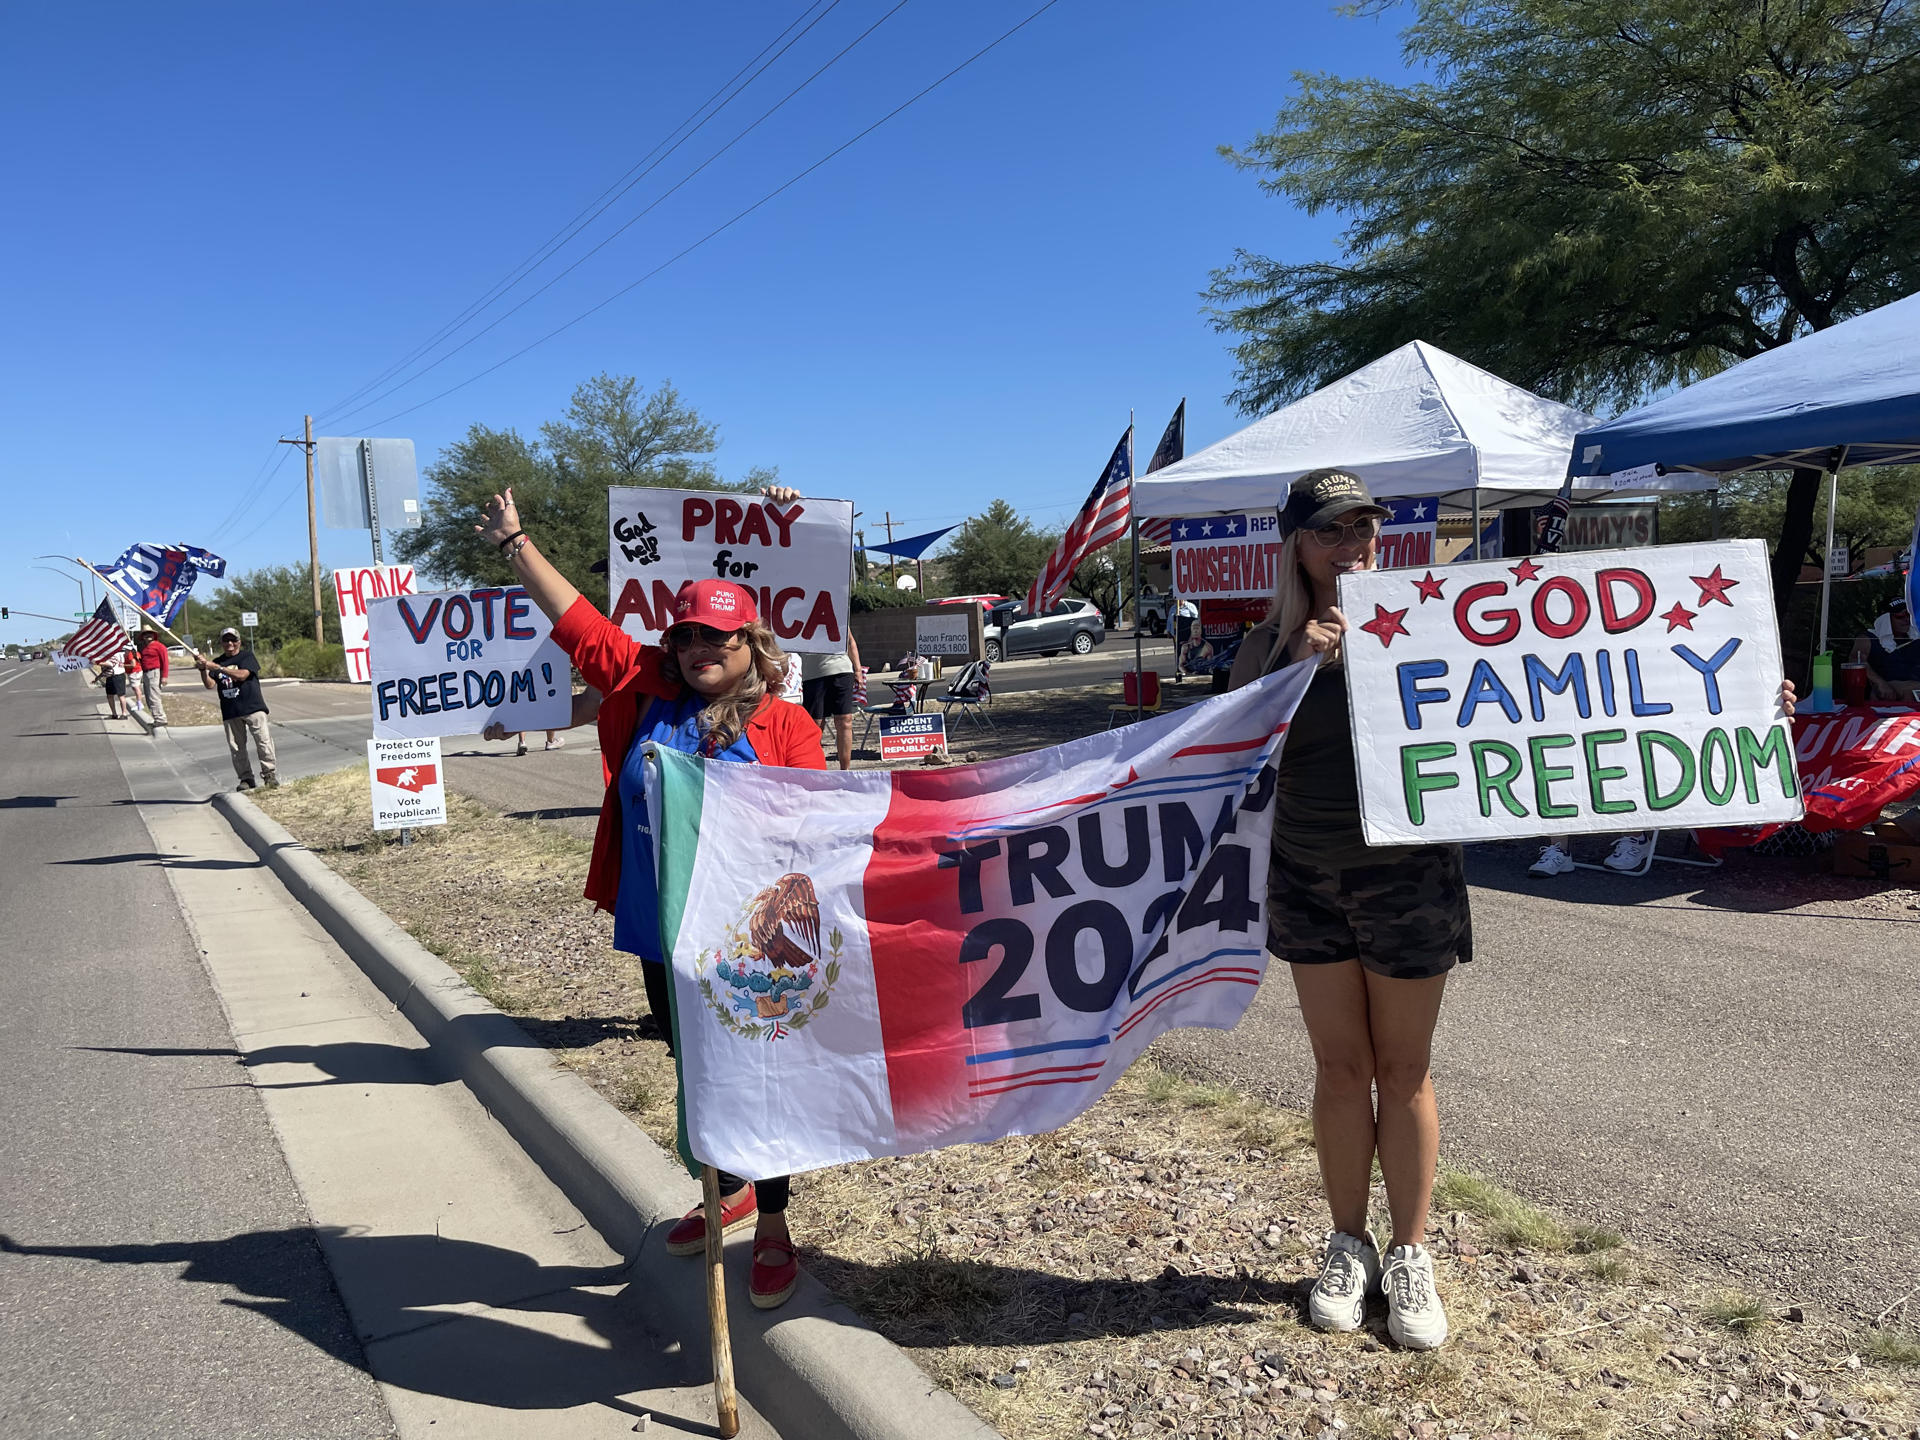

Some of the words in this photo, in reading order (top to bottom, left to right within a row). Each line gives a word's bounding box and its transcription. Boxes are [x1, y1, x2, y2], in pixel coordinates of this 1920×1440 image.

[1315, 474, 1357, 490] TRUMP
[1327, 484, 1350, 493] 2020
[613, 511, 657, 542] God
[682, 497, 805, 548] PRAY
[1561, 515, 1649, 546] MMY'S
[620, 536, 658, 563] help
[713, 550, 759, 579] for
[334, 568, 414, 617] HONK
[716, 590, 735, 599] PURO
[709, 602, 735, 612] TRUMP
[710, 596, 736, 606] PAPI
[1453, 567, 1656, 647] GOD
[397, 587, 537, 644] VOTE
[611, 578, 841, 642] AMICA
[918, 633, 939, 642] Aaron
[940, 632, 967, 642] Franco
[446, 639, 483, 662] FOR
[918, 643, 967, 653] 520.825.1800
[377, 662, 556, 721] FREEDOM!
[1397, 637, 1742, 730] FAMILY
[889, 717, 933, 726] STUDENT
[890, 724, 933, 734] SUCCESS
[375, 741, 413, 751] Protect
[416, 739, 434, 748] Our
[900, 736, 926, 745] VOTE
[380, 751, 432, 761] Freedoms
[1400, 725, 1797, 826] FREEDOM
[397, 798, 421, 806] Vote
[379, 806, 440, 820] Republican!
